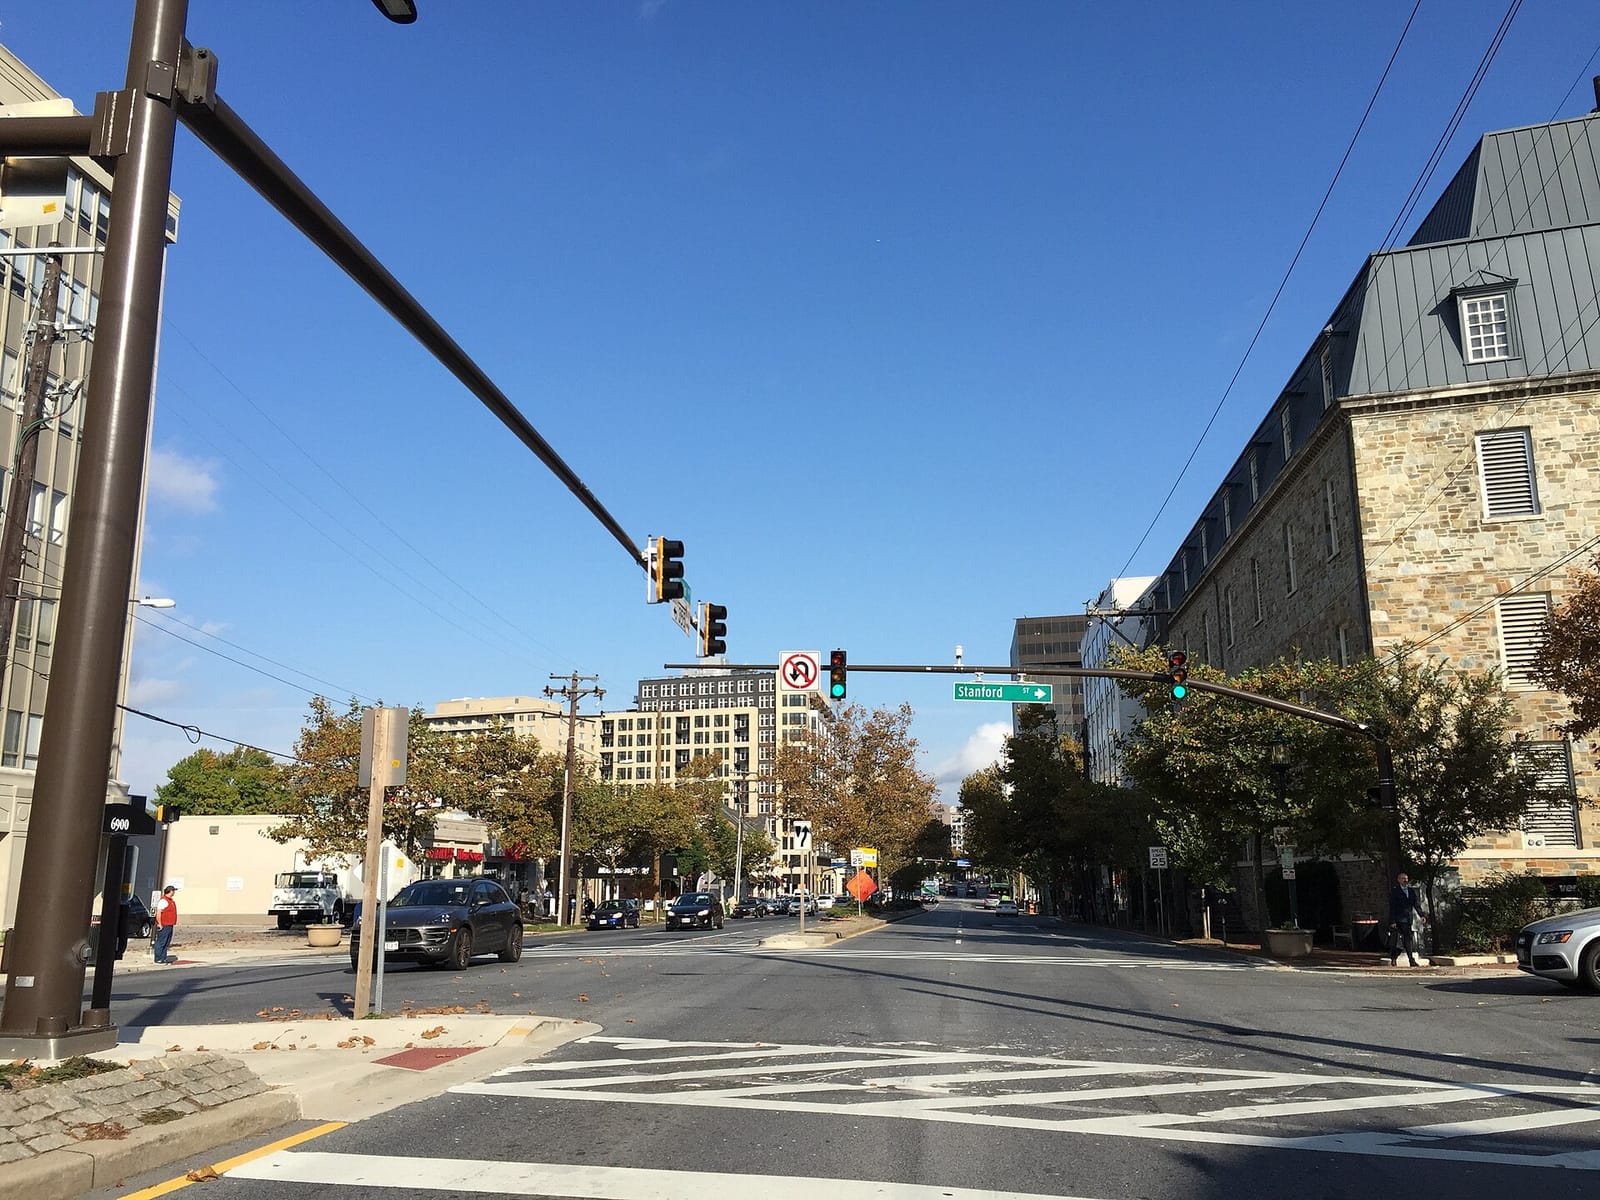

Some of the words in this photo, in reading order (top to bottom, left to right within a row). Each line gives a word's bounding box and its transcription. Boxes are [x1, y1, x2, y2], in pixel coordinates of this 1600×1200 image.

[958, 686, 1003, 698] Stanford
[110, 816, 130, 832] 6900
[852, 857, 863, 865] 25
[1151, 857, 1166, 867] 25
